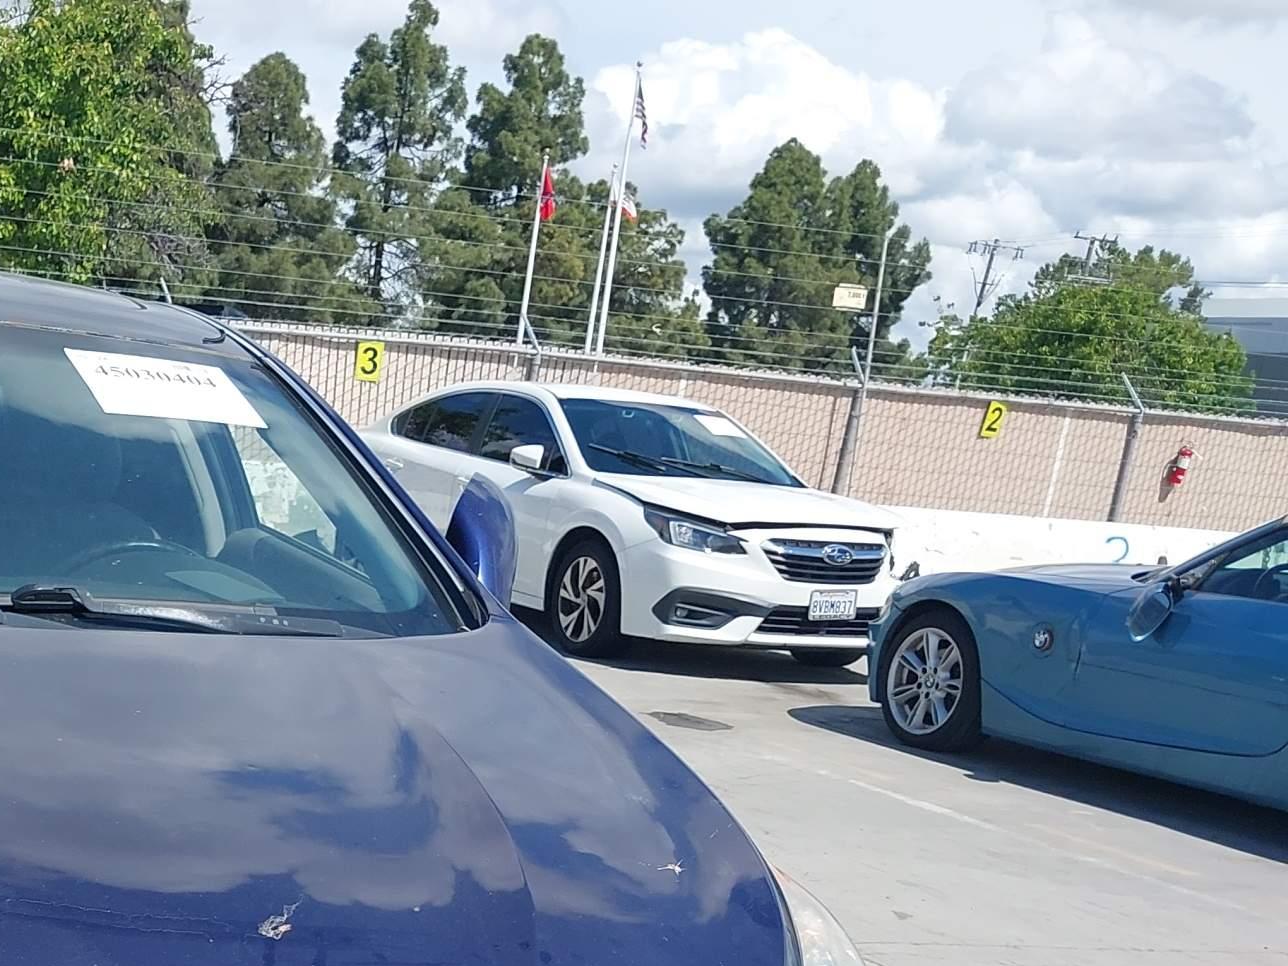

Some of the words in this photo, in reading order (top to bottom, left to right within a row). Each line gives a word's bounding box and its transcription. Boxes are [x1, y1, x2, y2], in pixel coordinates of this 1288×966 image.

[360, 347, 378, 375] 3
[95, 365, 217, 388] 45030404
[985, 407, 1003, 433] 2
